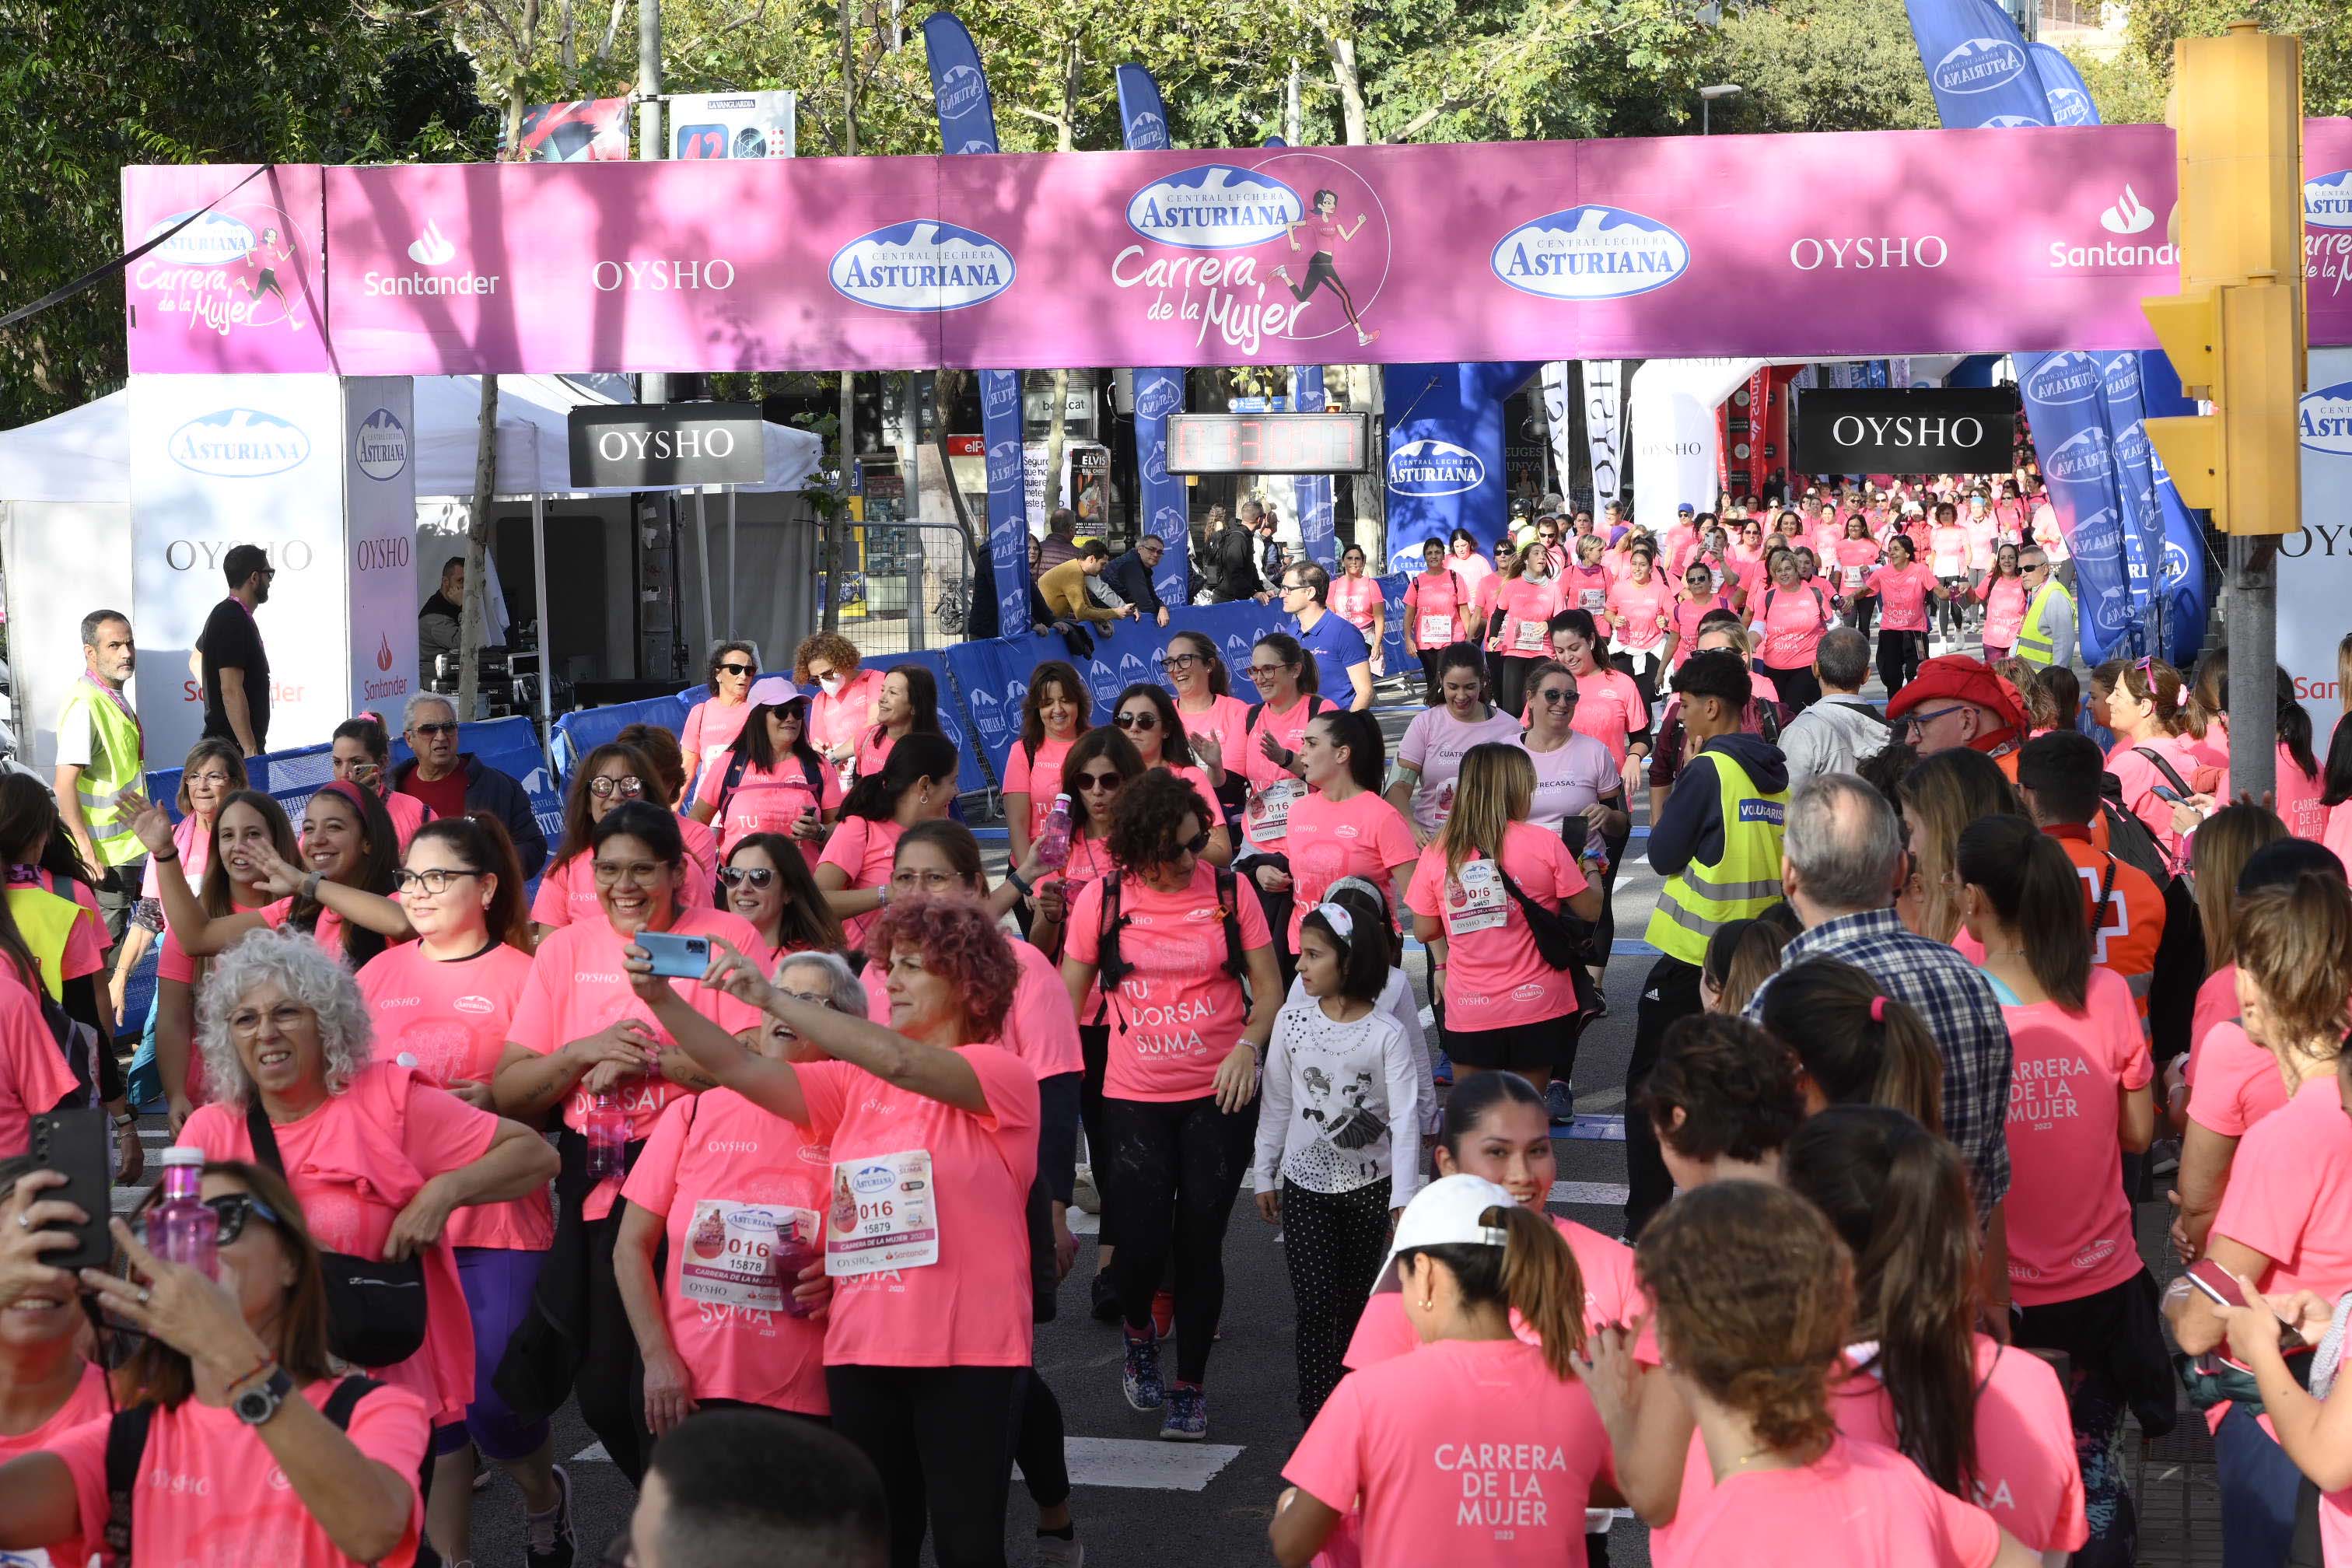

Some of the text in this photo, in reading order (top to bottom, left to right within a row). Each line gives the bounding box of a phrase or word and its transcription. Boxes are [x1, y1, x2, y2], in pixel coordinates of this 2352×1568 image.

[1167, 192, 1285, 204] CENTRAL LECHERA
[1140, 197, 1290, 229] ASTURIANA
[1537, 238, 1598, 249] CENTRAL
[1790, 236, 1948, 271] OYSHO
[872, 250, 996, 261] CENTRAL LECHERA
[1506, 241, 1675, 277] ASTURIANA
[2049, 241, 2182, 268] Santand
[135, 261, 227, 291] Carrera
[592, 259, 735, 291] OYSHO
[843, 254, 1002, 289] ASTURIANA
[1111, 245, 1257, 289] Carrera
[363, 271, 499, 296] Santander
[158, 286, 262, 336] de la Mujer
[1147, 282, 1312, 356] de la Mujer
[1832, 416, 1983, 448] OYSHO
[180, 435, 299, 460] ASTURIANA
[359, 436, 405, 464] ASTURIANA
[599, 428, 734, 461] OYSHO
[1082, 455, 1107, 466] ELVIS
[1389, 463, 1478, 485] ASTURIANA
[357, 537, 409, 572] OYSHO
[1774, 642, 1799, 650] SUMA
[364, 677, 408, 702] Santander
[1268, 801, 1289, 813] 016
[738, 815, 758, 828] TU
[2299, 811, 2322, 825] DE LA
[1468, 887, 1491, 899] 016
[1456, 910, 1477, 919] CARRERA
[1457, 919, 1480, 929] OYSHO
[574, 971, 620, 984] OYSHO
[1121, 980, 1148, 999] TU
[381, 996, 421, 1010] OYSHO
[1458, 996, 1490, 1006] OYSHO
[1132, 996, 1216, 1027] DORSAL
[1136, 1029, 1203, 1054] SUMA
[2009, 1080, 2073, 1102] DE LA
[2007, 1098, 2079, 1125] MUJER
[708, 1141, 758, 1153] OYSHO
[856, 1177, 892, 1189] ASTURIANA
[859, 1200, 894, 1220] 016
[864, 1222, 891, 1235] 15879
[728, 1238, 770, 1258] 016
[840, 1240, 867, 1251] CARRERA
[885, 1235, 908, 1244] MUJER
[837, 1255, 870, 1269] OYSHO
[894, 1248, 931, 1259] Santander
[695, 1268, 729, 1279] CARRERA
[730, 1259, 762, 1272] 15878
[688, 1283, 727, 1296] OYSHO
[1434, 1443, 1567, 1472] CARRERA
[1462, 1472, 1543, 1498] DE LA
[1456, 1500, 1549, 1526] MUJER
